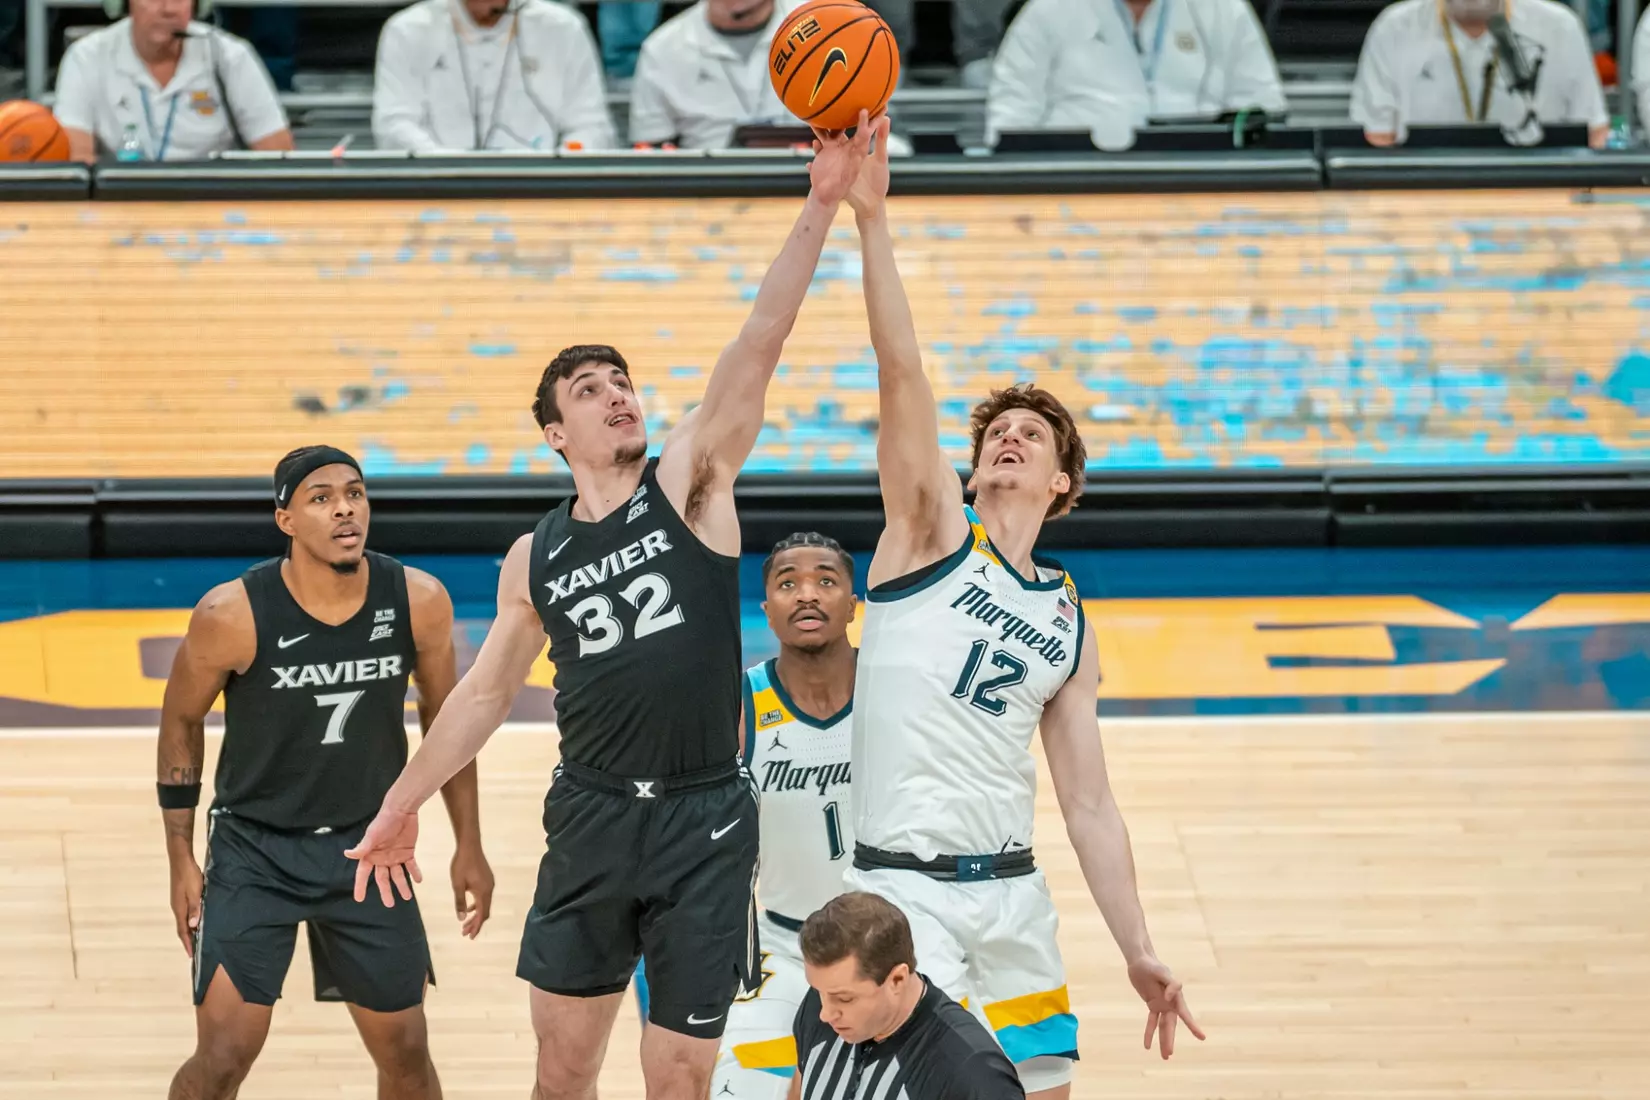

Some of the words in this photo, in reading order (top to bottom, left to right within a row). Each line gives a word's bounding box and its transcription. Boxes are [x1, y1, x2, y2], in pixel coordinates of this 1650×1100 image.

[773, 18, 822, 76] ELITE
[544, 528, 674, 606] XAVIER
[564, 572, 686, 659] 32
[949, 582, 1067, 668] Marquette
[1051, 619, 1072, 633] EAST
[270, 654, 402, 689] XAVIER
[950, 638, 1029, 717] 12
[313, 690, 367, 745] 7
[823, 801, 846, 861] 1
